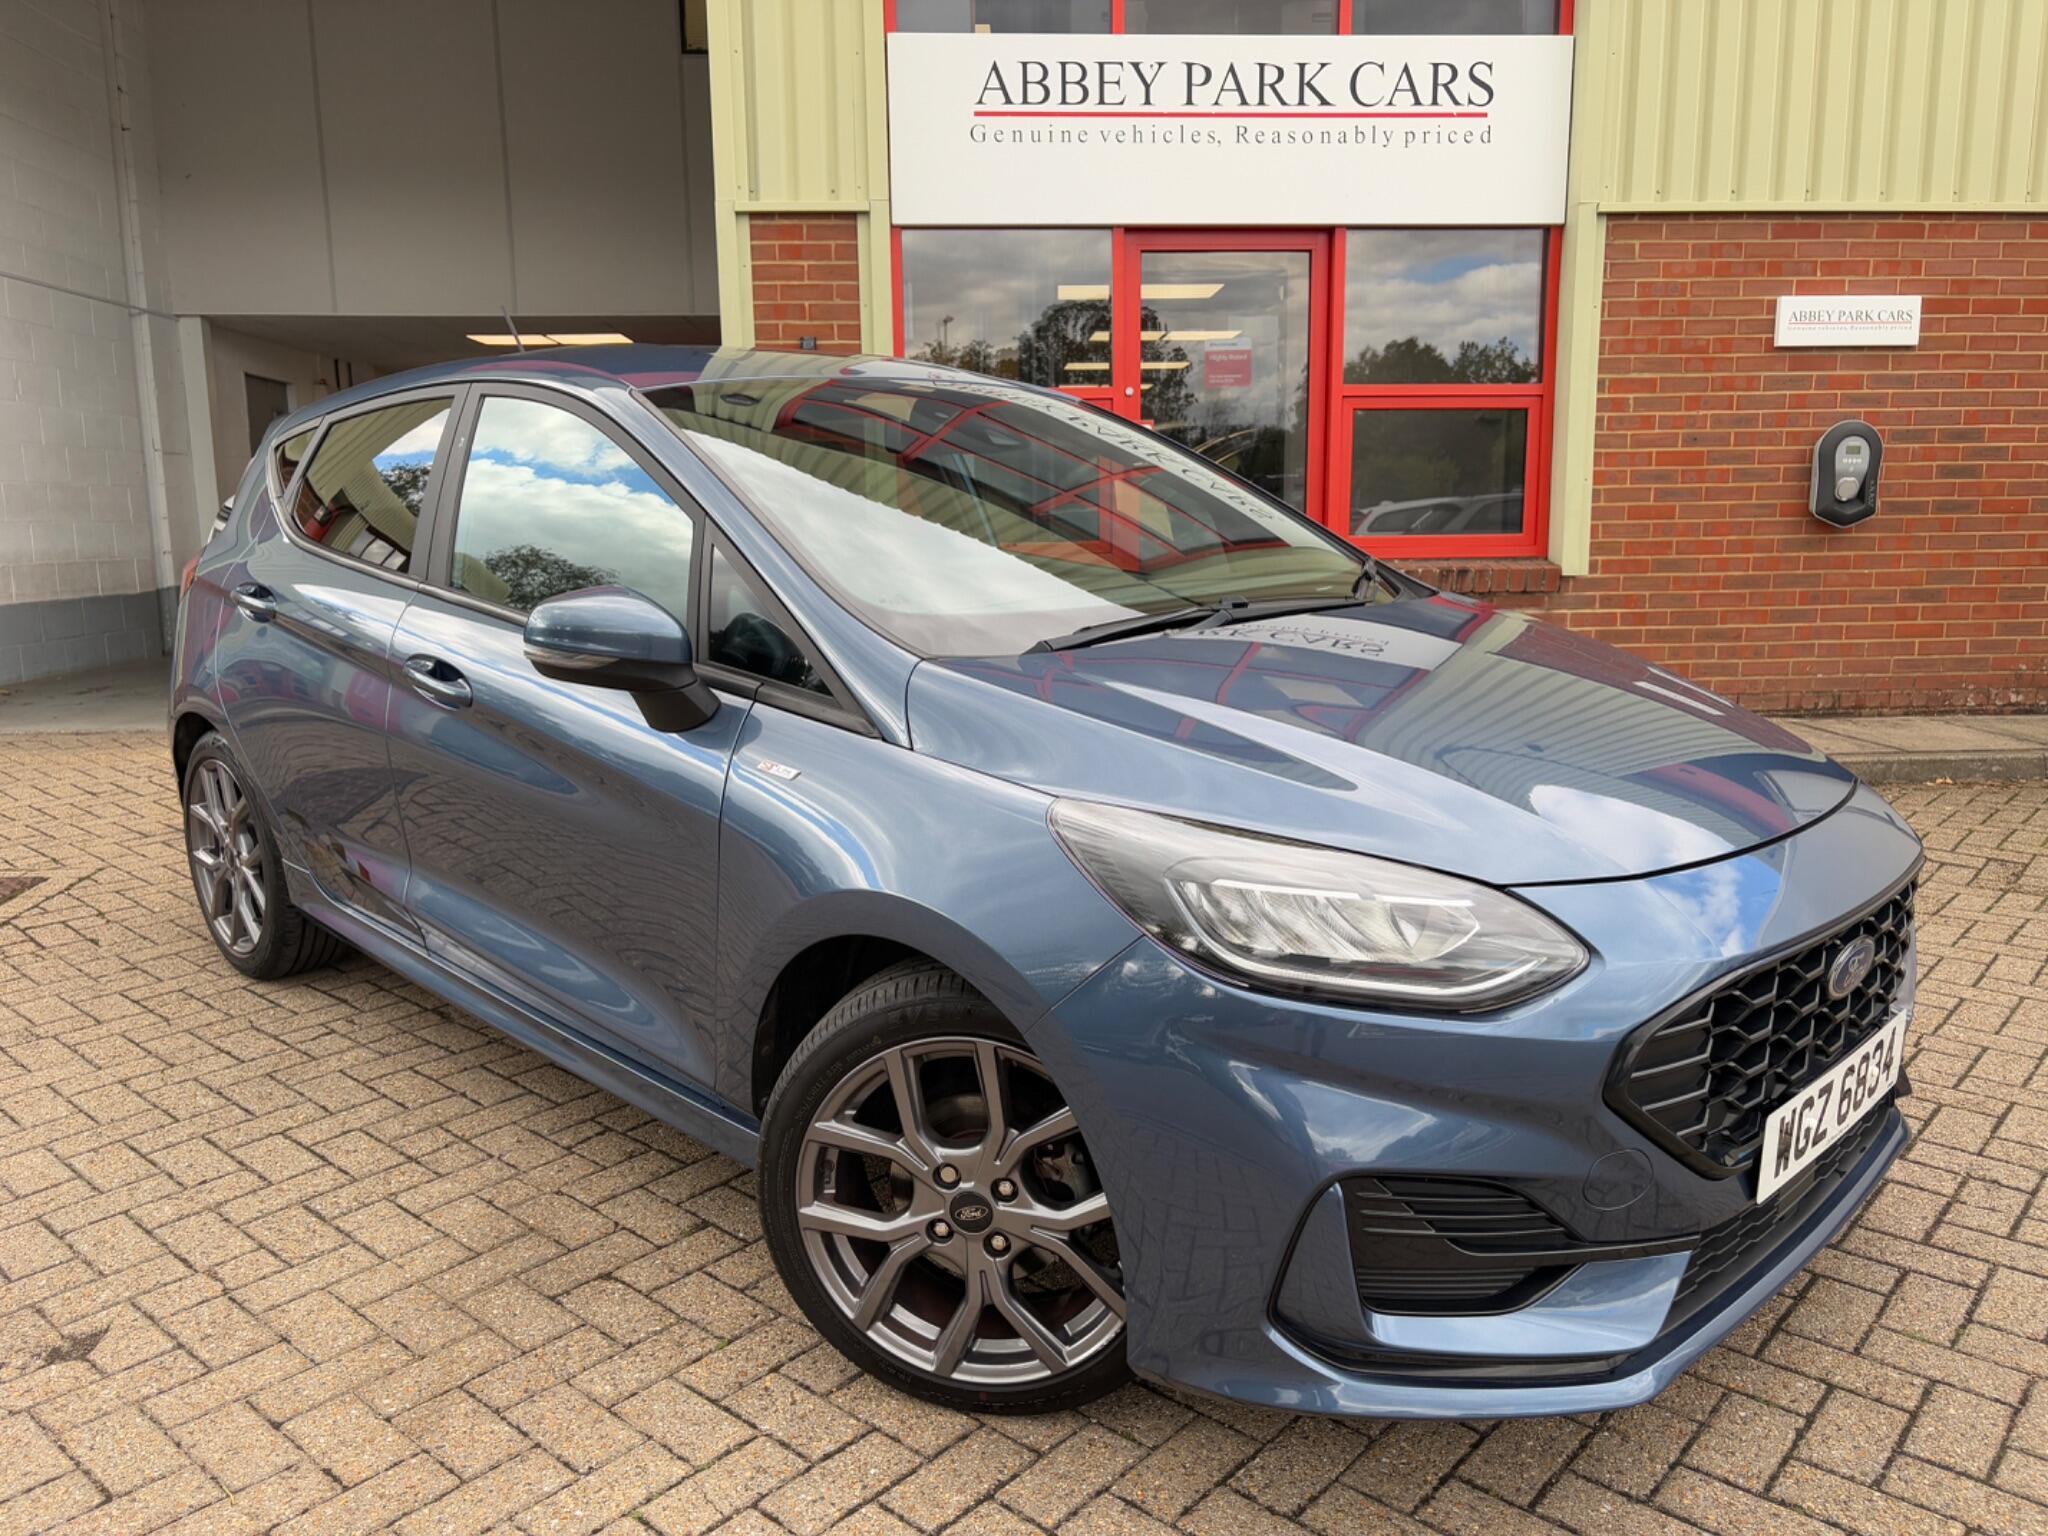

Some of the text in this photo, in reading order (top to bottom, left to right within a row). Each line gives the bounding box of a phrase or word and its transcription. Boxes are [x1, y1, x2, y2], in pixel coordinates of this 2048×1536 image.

[976, 60, 1495, 107] ABBEY PARK CARS
[969, 123, 1492, 149] Genuine vehicles, Reasonably priced
[1789, 308, 1913, 322] ABBEY PARK CARS
[1774, 1026, 1897, 1179] WGZ 6834
[960, 1207, 982, 1220] Ford
